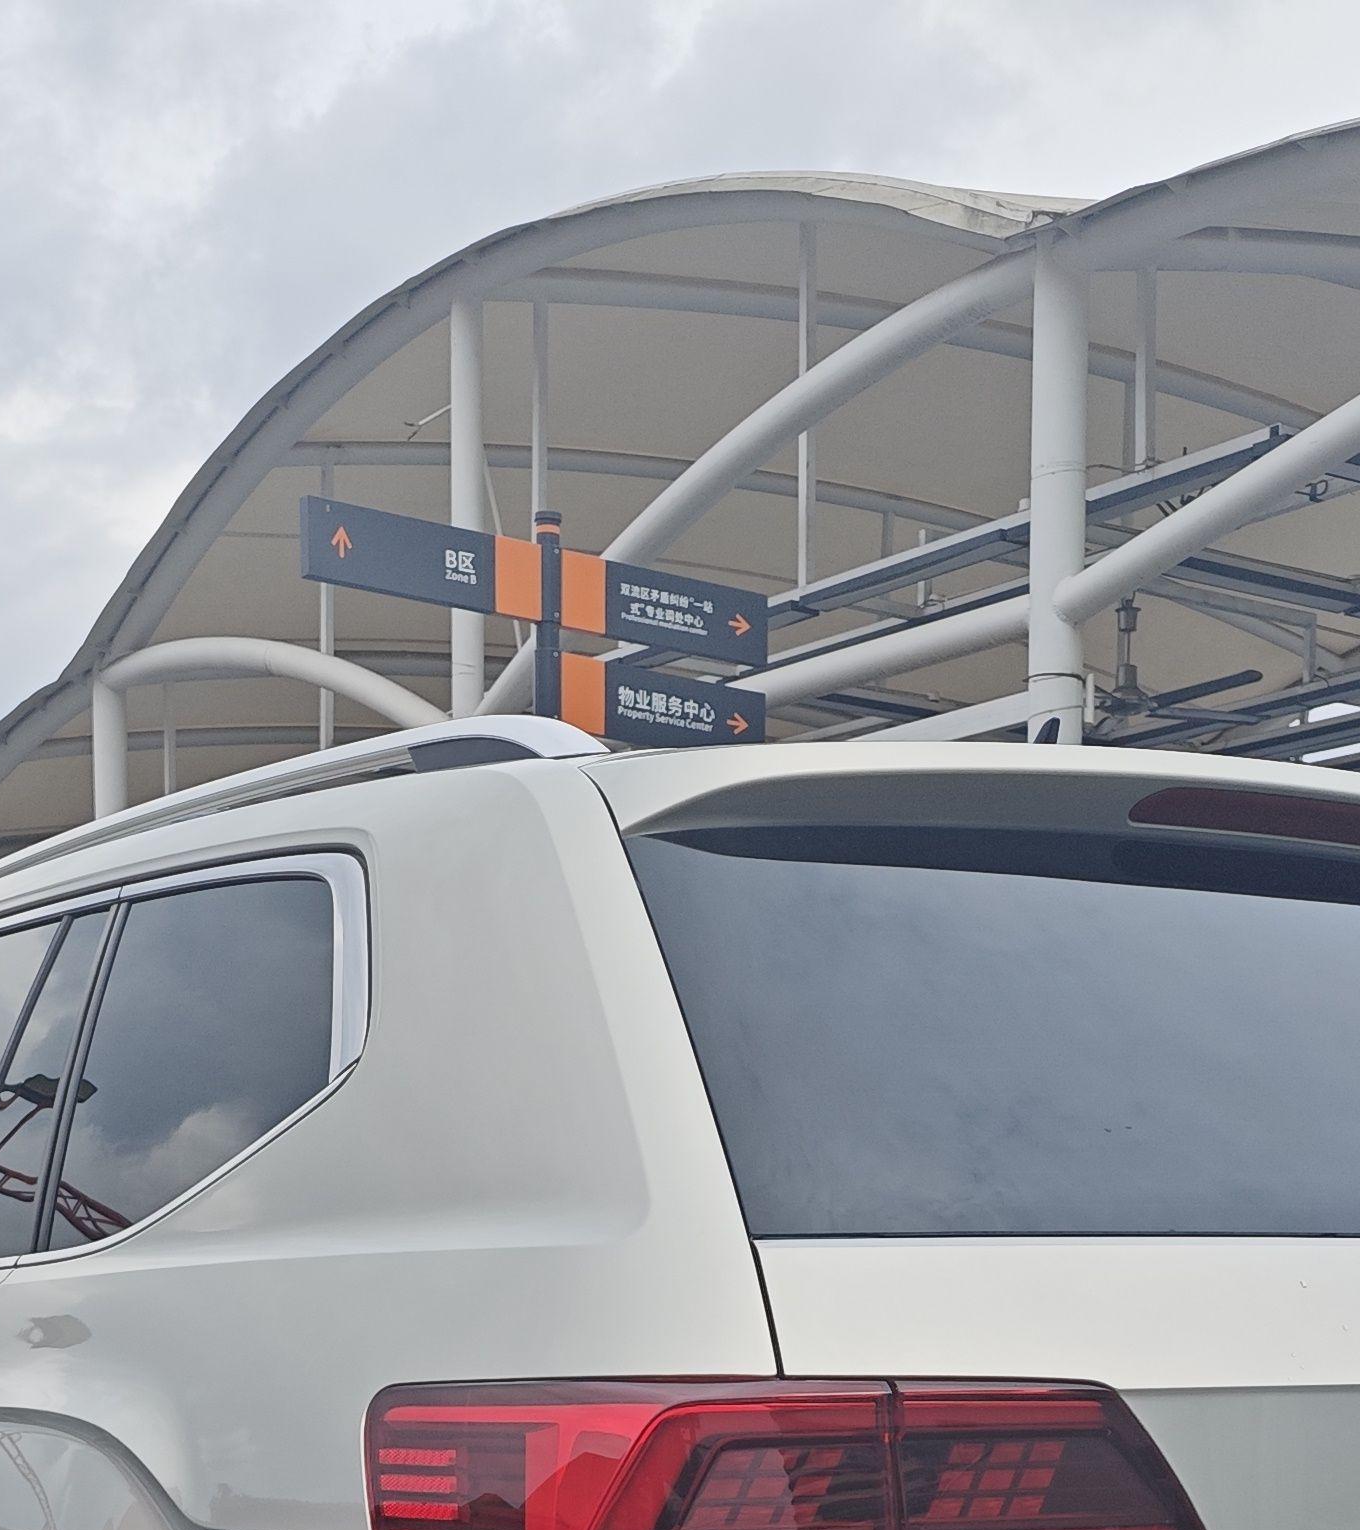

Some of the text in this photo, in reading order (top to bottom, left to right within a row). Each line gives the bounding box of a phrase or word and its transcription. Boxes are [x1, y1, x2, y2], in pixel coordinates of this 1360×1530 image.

[445, 549, 476, 574] B区
[445, 569, 477, 585] Zone B
[618, 685, 716, 722] 物业服务中心
[617, 705, 714, 732] Property Service Center
